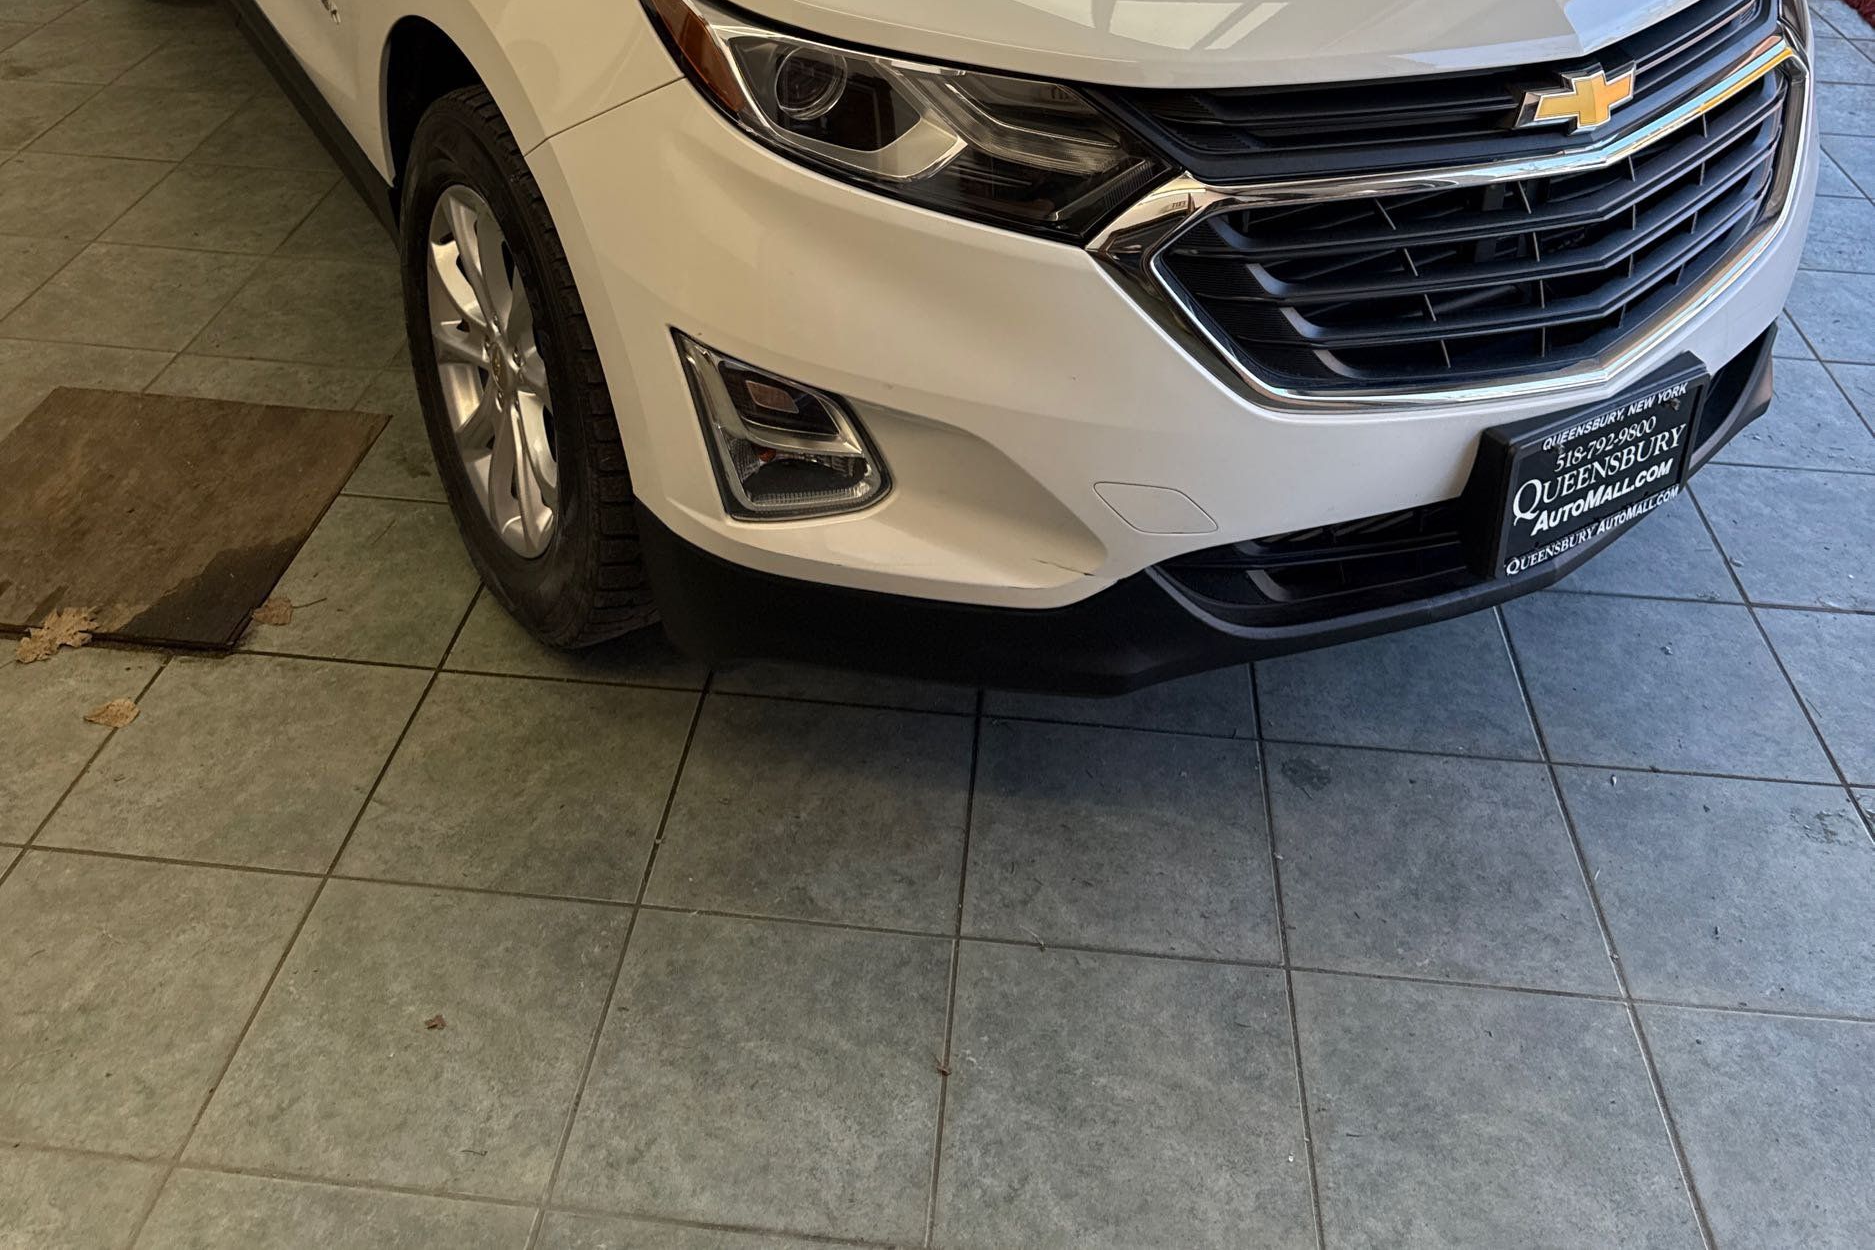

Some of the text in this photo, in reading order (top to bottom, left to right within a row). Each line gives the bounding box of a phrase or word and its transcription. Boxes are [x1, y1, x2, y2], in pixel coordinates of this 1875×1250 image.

[1542, 381, 1689, 451] QUEENSBURY, NEW YORK
[1556, 415, 1657, 473] 518-792-9800
[1512, 423, 1687, 527] QUEENSBURY
[1530, 457, 1674, 537] AUTOMALL.COM
[1505, 522, 1599, 576] QUEENSBURY
